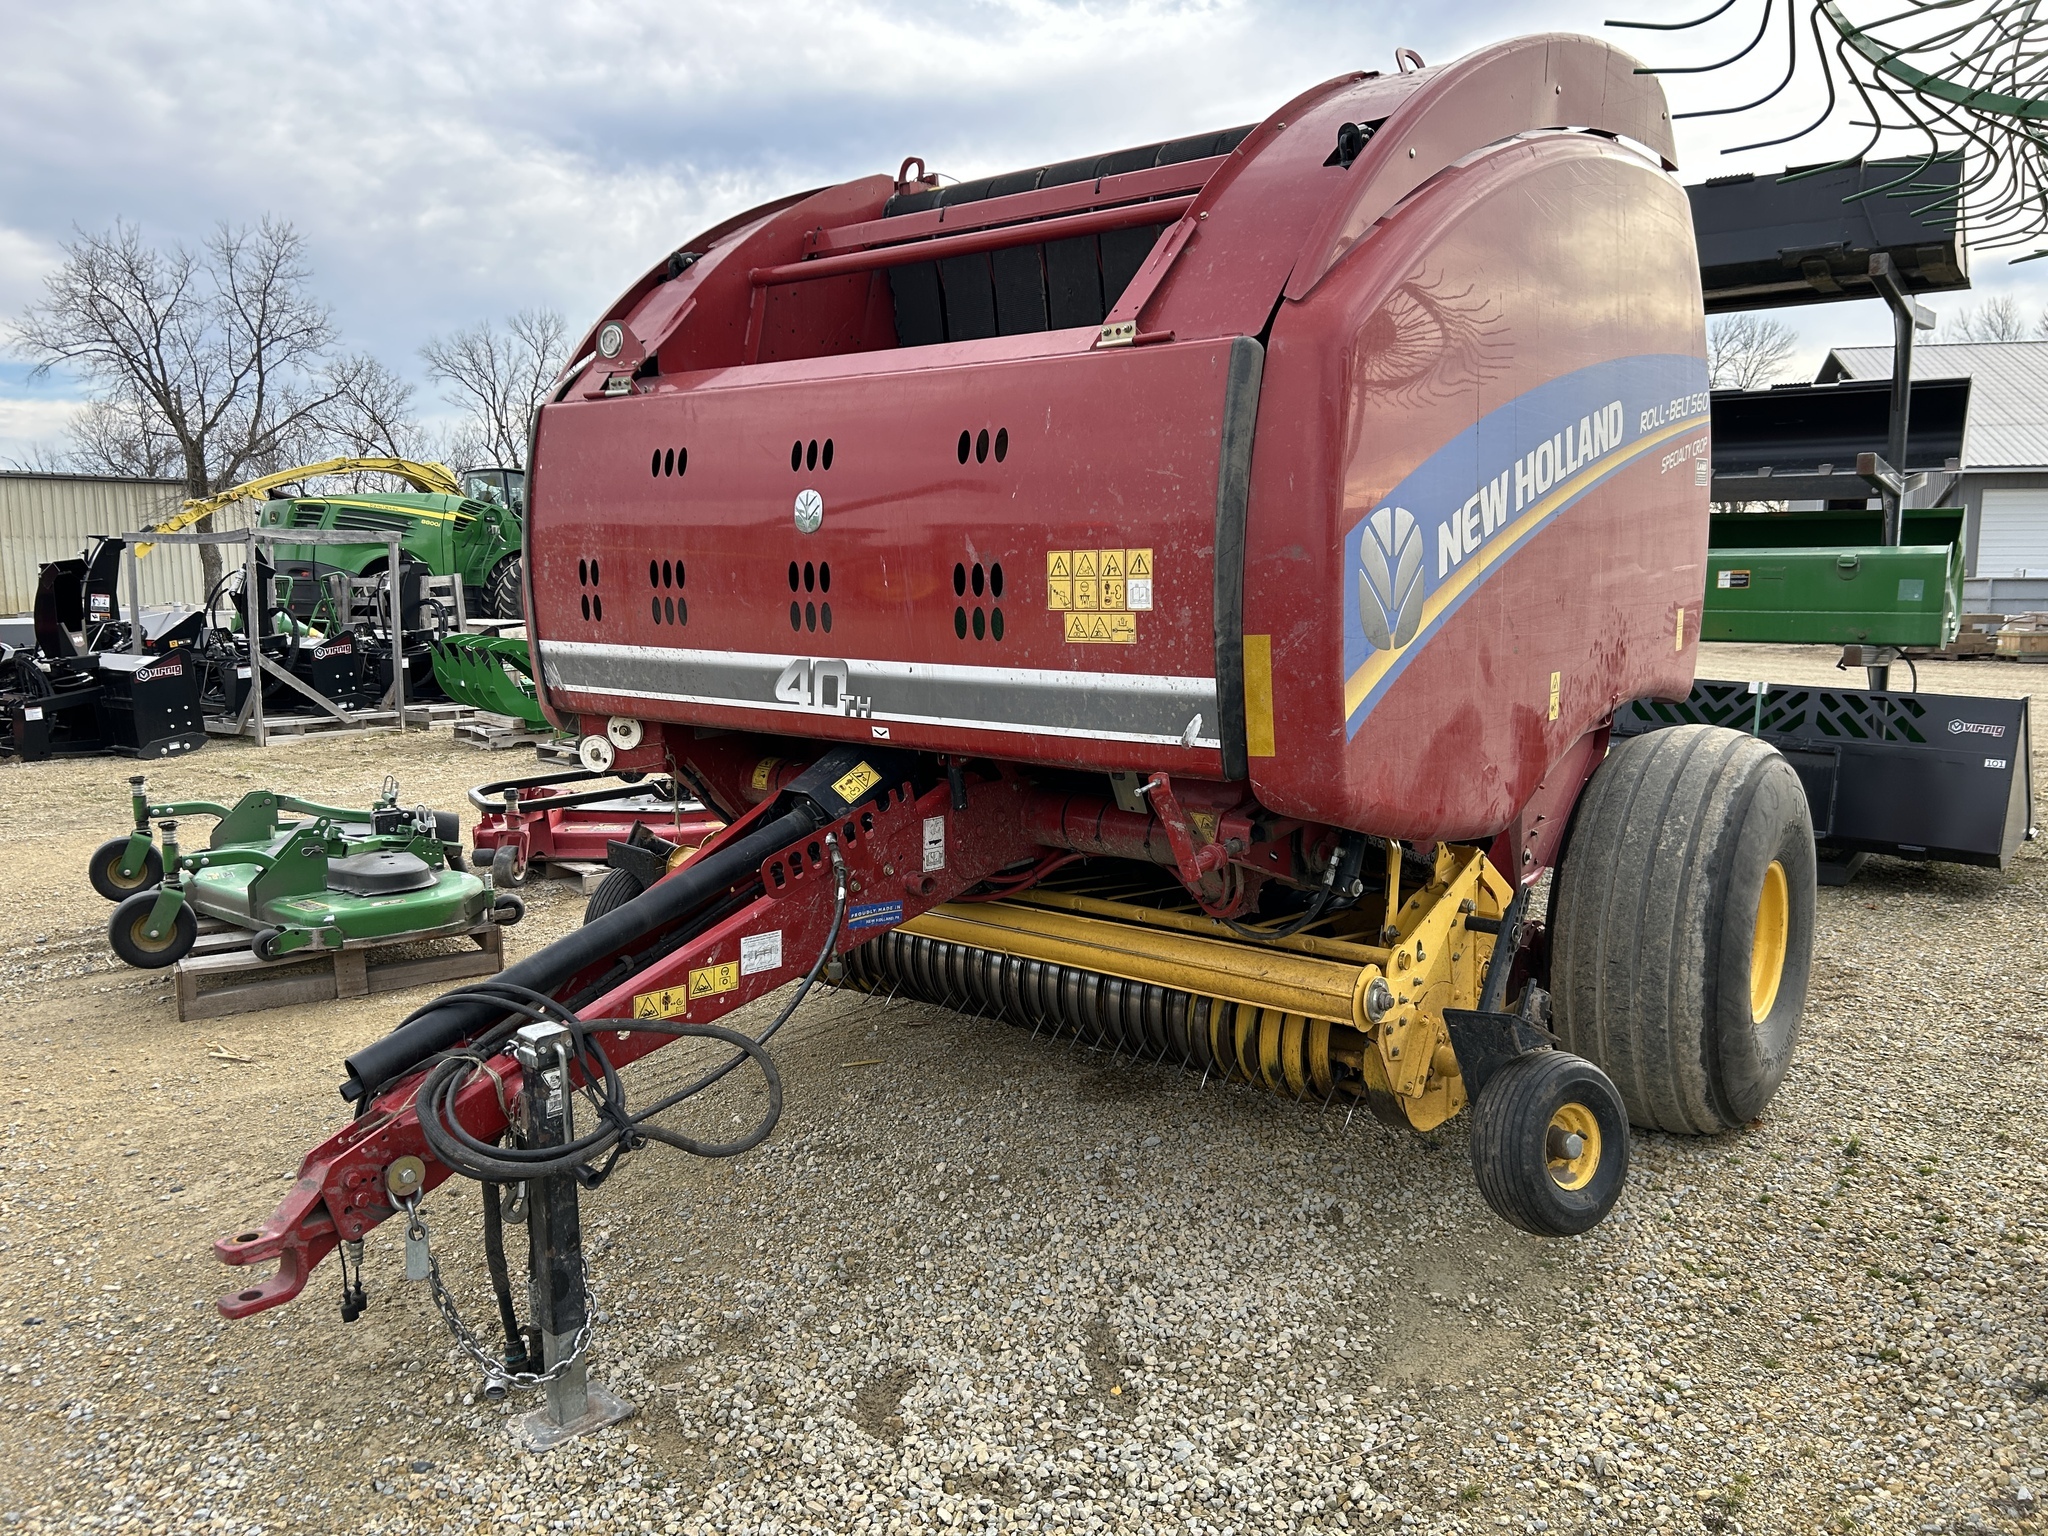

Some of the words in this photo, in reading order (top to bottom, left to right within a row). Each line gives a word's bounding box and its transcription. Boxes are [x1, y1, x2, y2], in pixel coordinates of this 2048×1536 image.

[1640, 395, 1690, 433] ROLL-BELT
[1690, 391, 1708, 414] 560
[1661, 442, 1692, 474] SPECIALTY
[1692, 436, 1708, 457] CROP
[1438, 469, 1509, 579] NEW
[1515, 400, 1623, 512] HOLLAND
[325, 643, 352, 656] virnig
[150, 664, 182, 678] virnig
[1964, 722, 2006, 738] virnig
[1986, 759, 2005, 769] 101
[850, 907, 877, 919] PROUDLY
[877, 905, 893, 913] MADE
